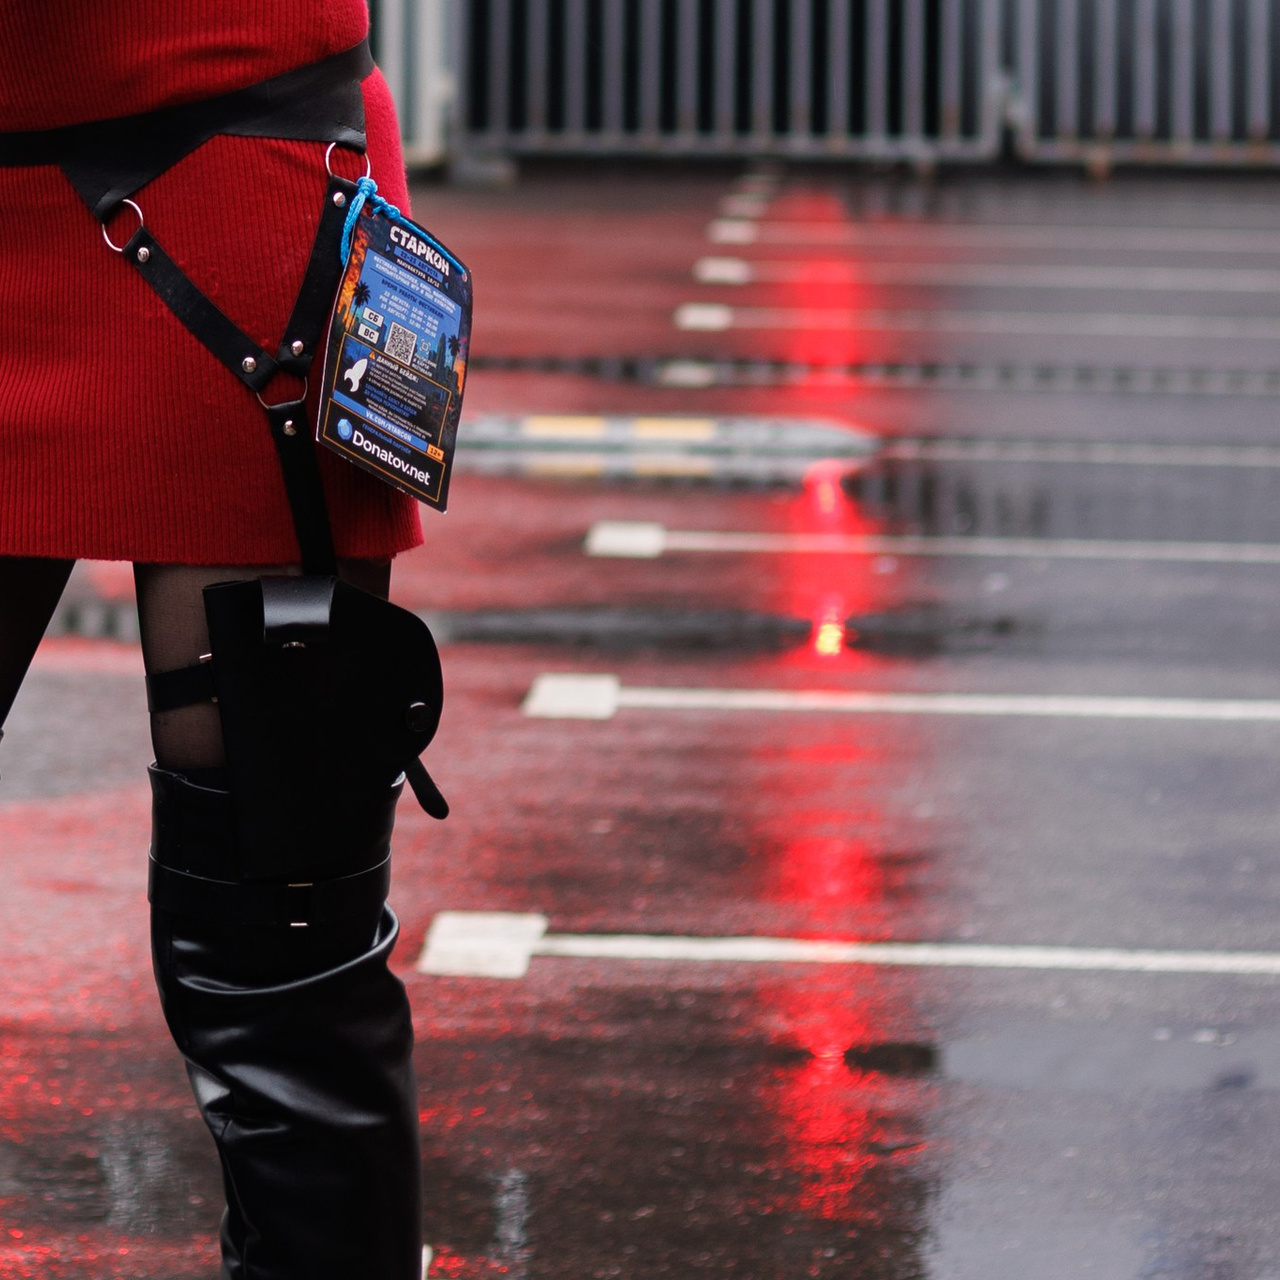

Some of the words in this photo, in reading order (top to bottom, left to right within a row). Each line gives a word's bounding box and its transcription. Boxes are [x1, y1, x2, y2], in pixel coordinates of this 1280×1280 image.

[389, 225, 450, 276] СТАРКОН
[400, 251, 417, 265] 22-23
[418, 260, 438, 278] АВГУСТА
[398, 287, 417, 303] РАБОТЫ
[368, 312, 379, 322] СБ
[364, 328, 375, 340] ВС
[365, 410, 412, 442] VK.COM/STARCON
[352, 430, 430, 485] Donatov.net
[430, 447, 441, 457] 12+
